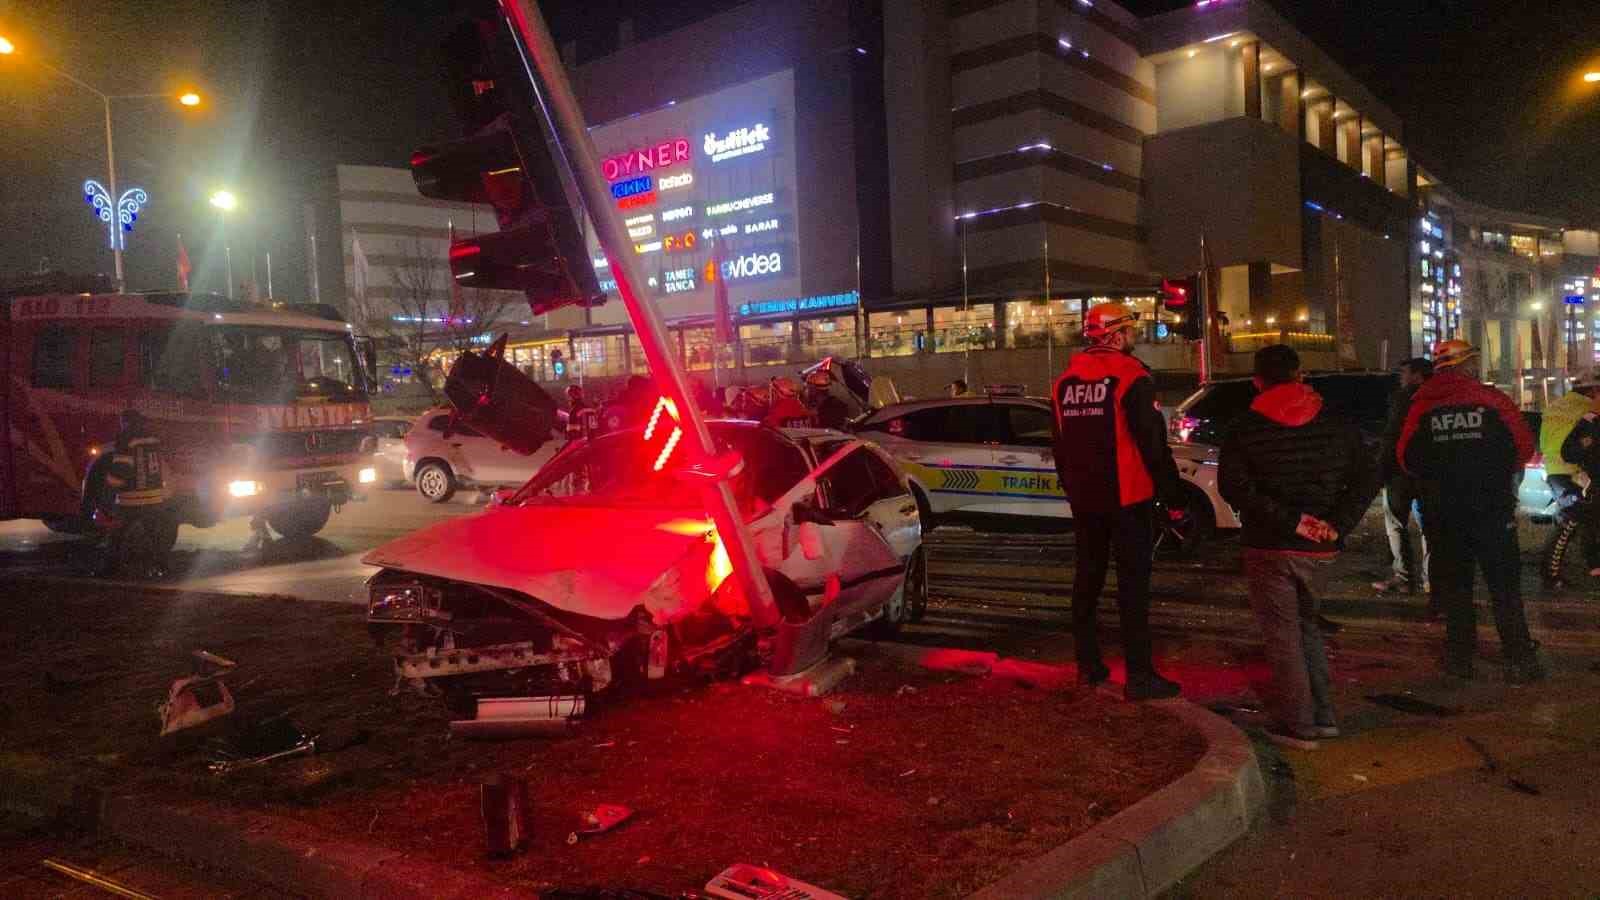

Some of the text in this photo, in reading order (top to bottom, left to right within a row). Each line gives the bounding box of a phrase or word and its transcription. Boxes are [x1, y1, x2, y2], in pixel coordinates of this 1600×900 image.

[603, 139, 690, 180] OYNER
[745, 219, 778, 234] SARAR
[665, 280, 695, 293] TANCA
[1063, 383, 1106, 405] AFAD
[1431, 411, 1482, 431] AFAD
[1001, 473, 1051, 489] TRAFİK
